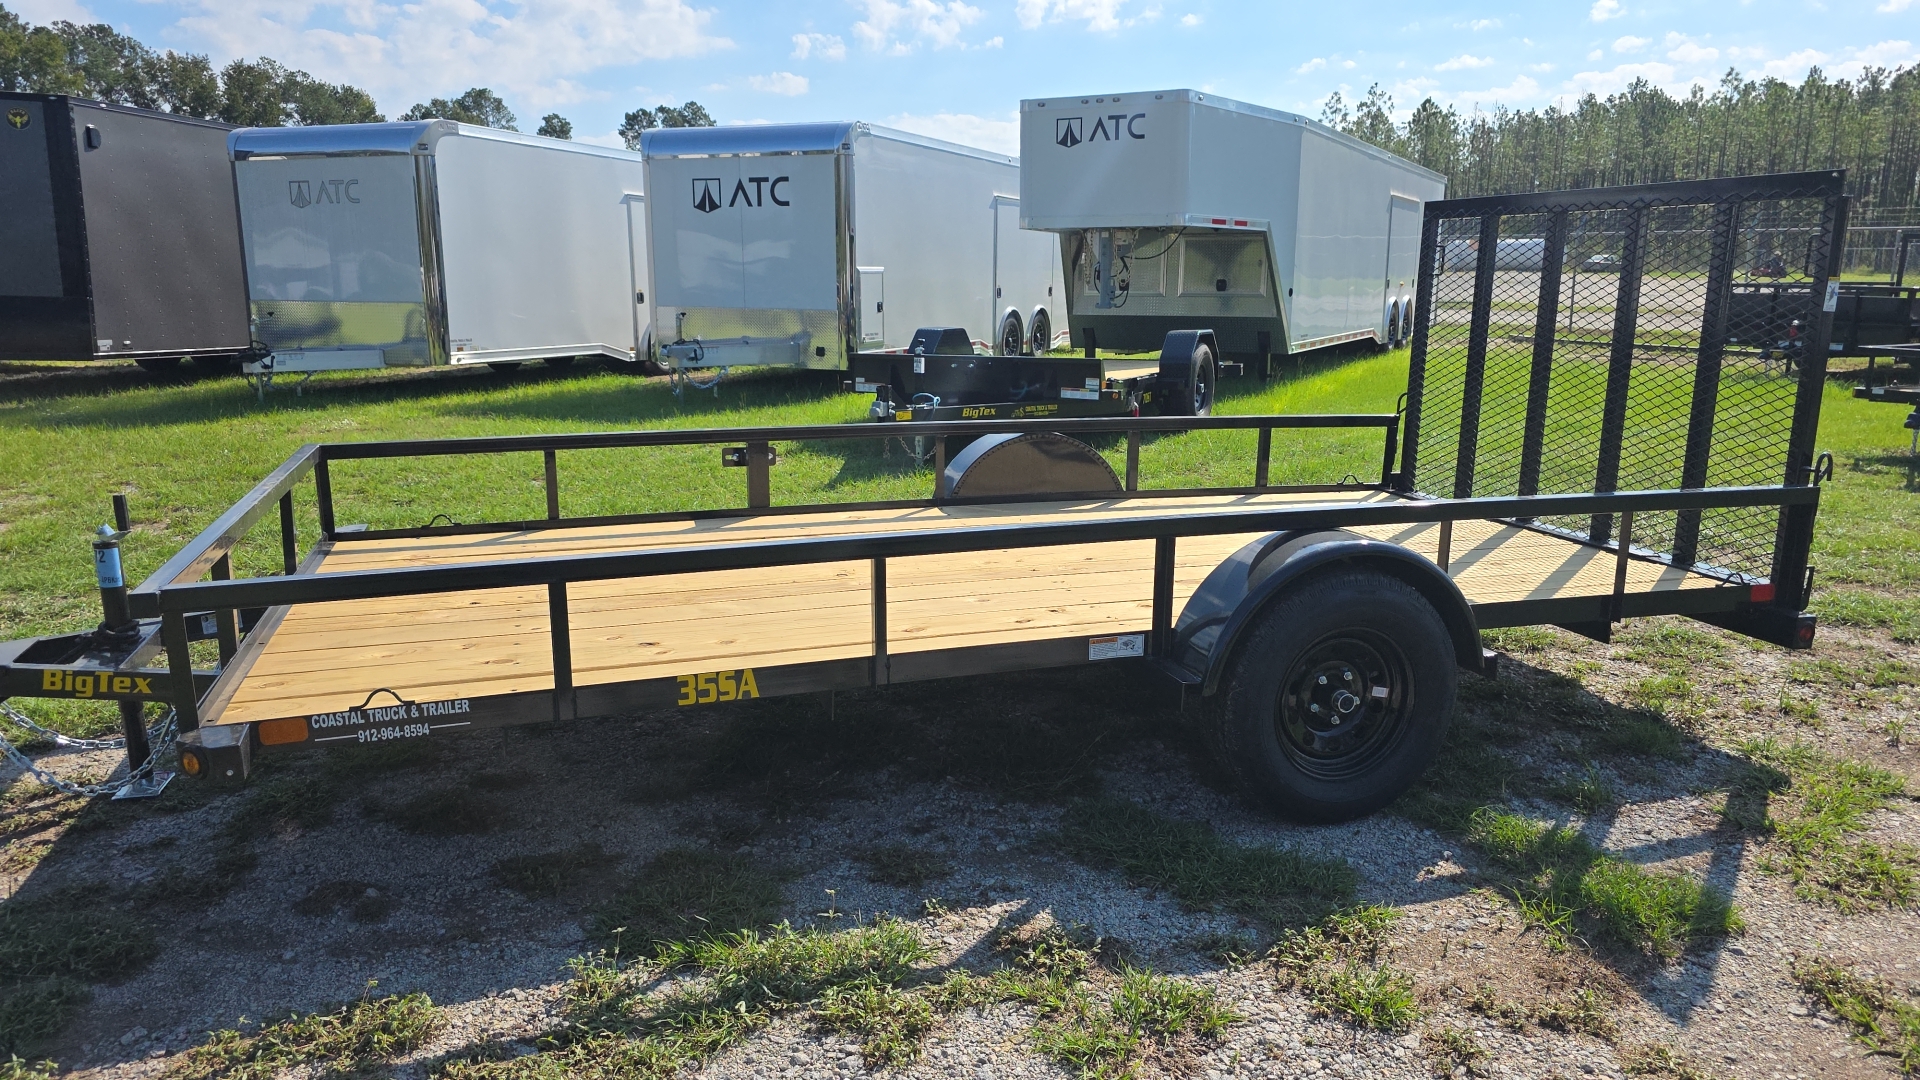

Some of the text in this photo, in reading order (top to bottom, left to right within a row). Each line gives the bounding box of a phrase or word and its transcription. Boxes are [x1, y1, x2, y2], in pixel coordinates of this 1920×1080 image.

[1088, 113, 1146, 142] ATC
[316, 179, 360, 204] ATC
[728, 176, 790, 207] ATC
[962, 407, 996, 418] BigTex
[42, 669, 153, 697] BigTex
[311, 700, 470, 729] COASTAL TRUCK & TRAILER
[358, 723, 430, 743] 912-964-8594
